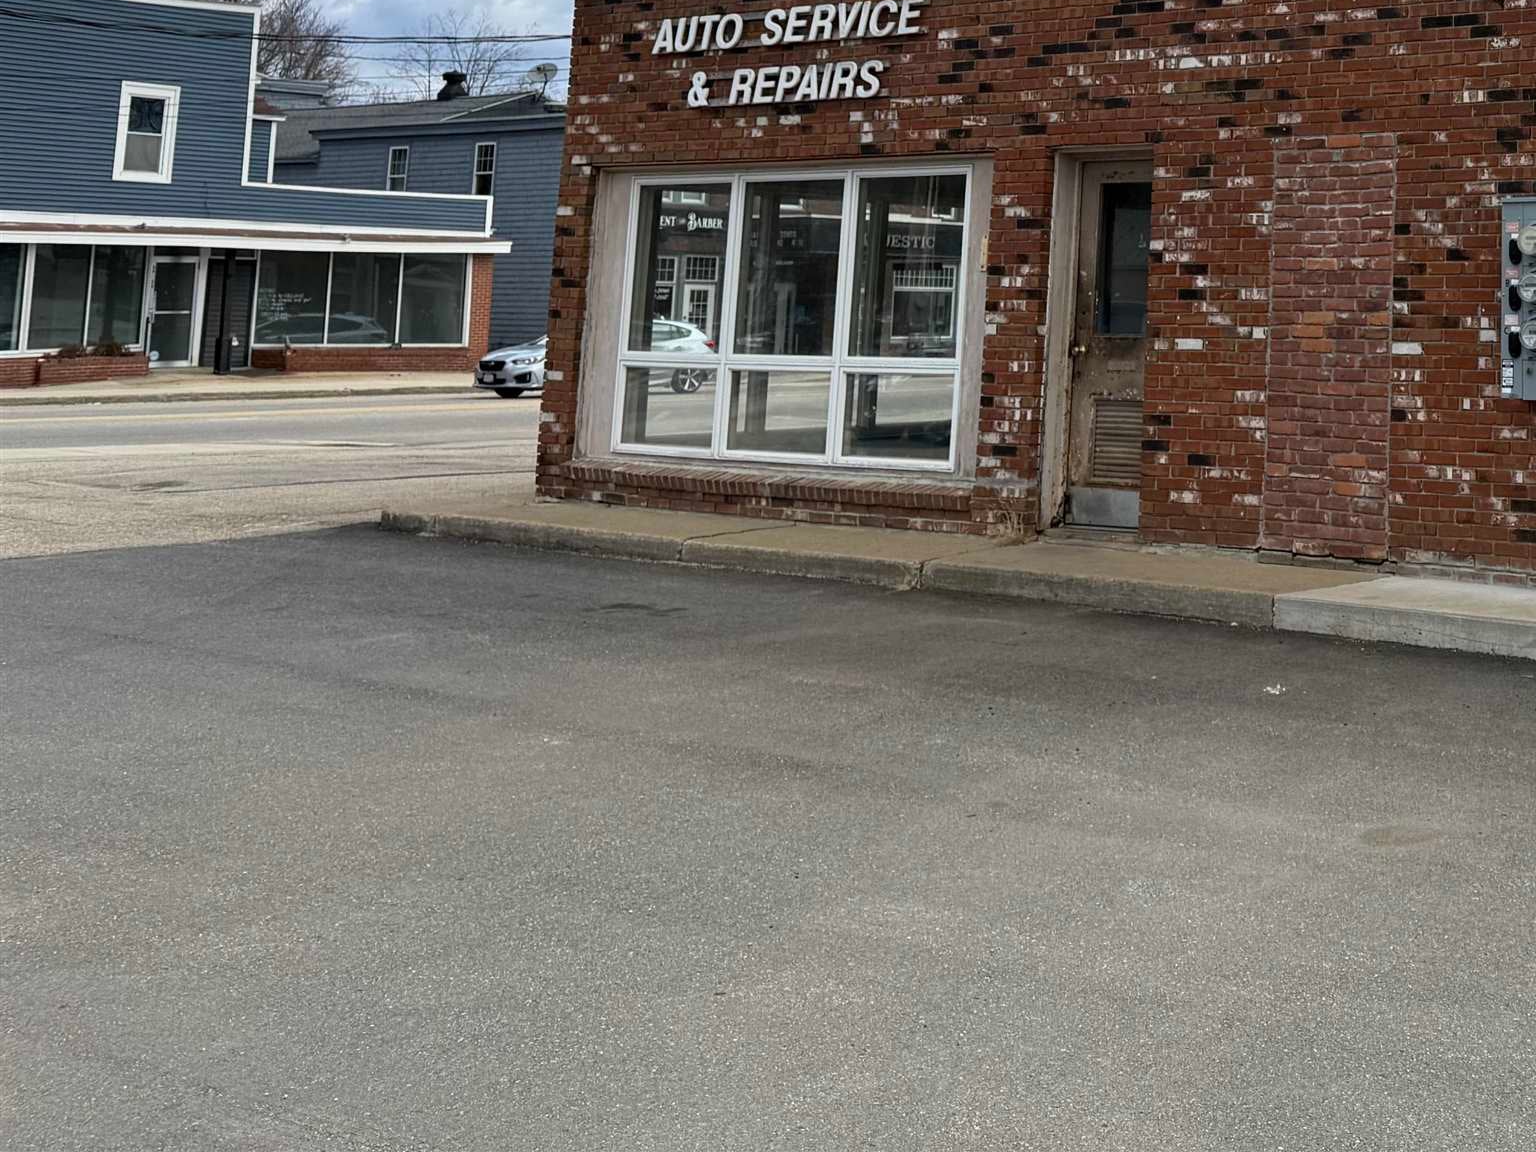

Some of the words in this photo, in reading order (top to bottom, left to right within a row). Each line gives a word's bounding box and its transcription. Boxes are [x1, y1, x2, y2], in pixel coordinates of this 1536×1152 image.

[652, 13, 744, 55] AUTO
[687, 71, 710, 108] &
[728, 59, 885, 104] REPAIRS
[659, 215, 677, 228] ENT
